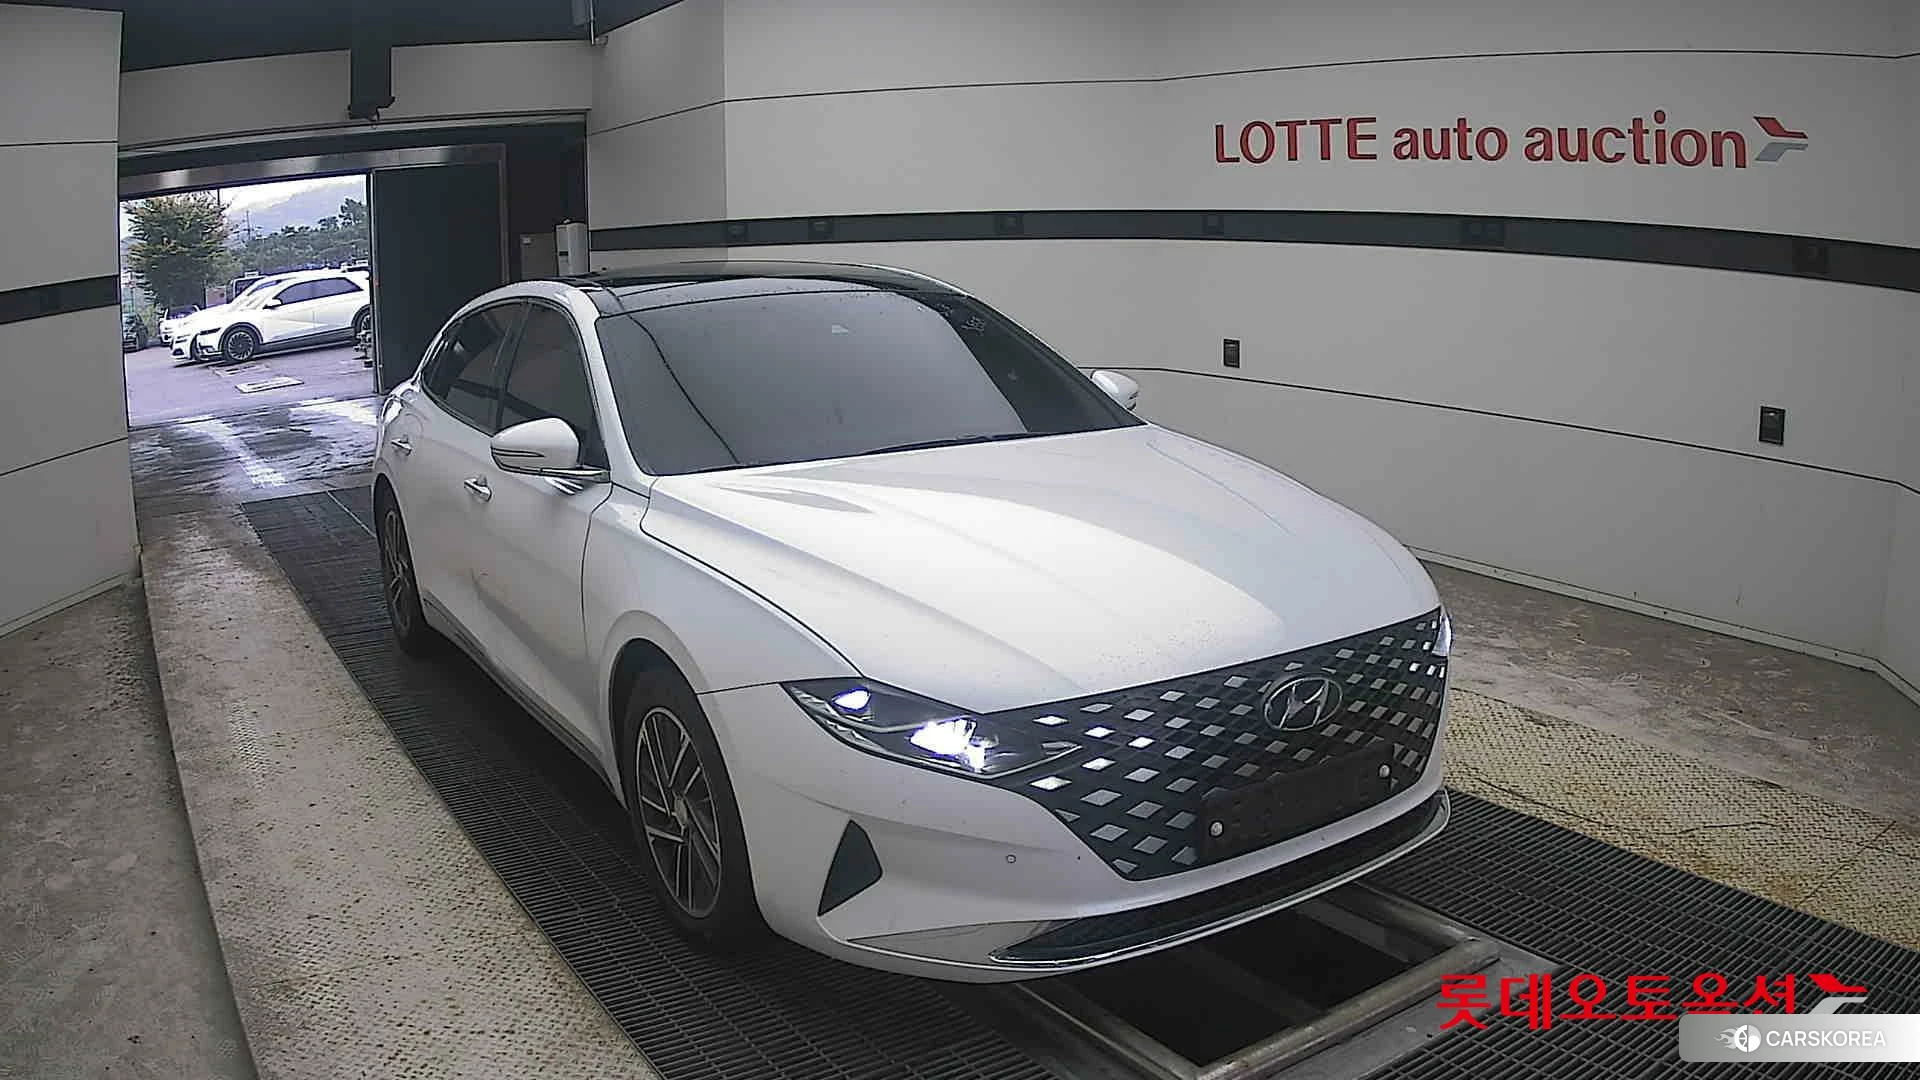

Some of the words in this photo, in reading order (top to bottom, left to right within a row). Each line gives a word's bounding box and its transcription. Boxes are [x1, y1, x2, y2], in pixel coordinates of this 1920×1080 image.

[1215, 117, 1377, 163] LOTTE
[1392, 117, 1507, 161] auto
[1523, 110, 1747, 168] auction
